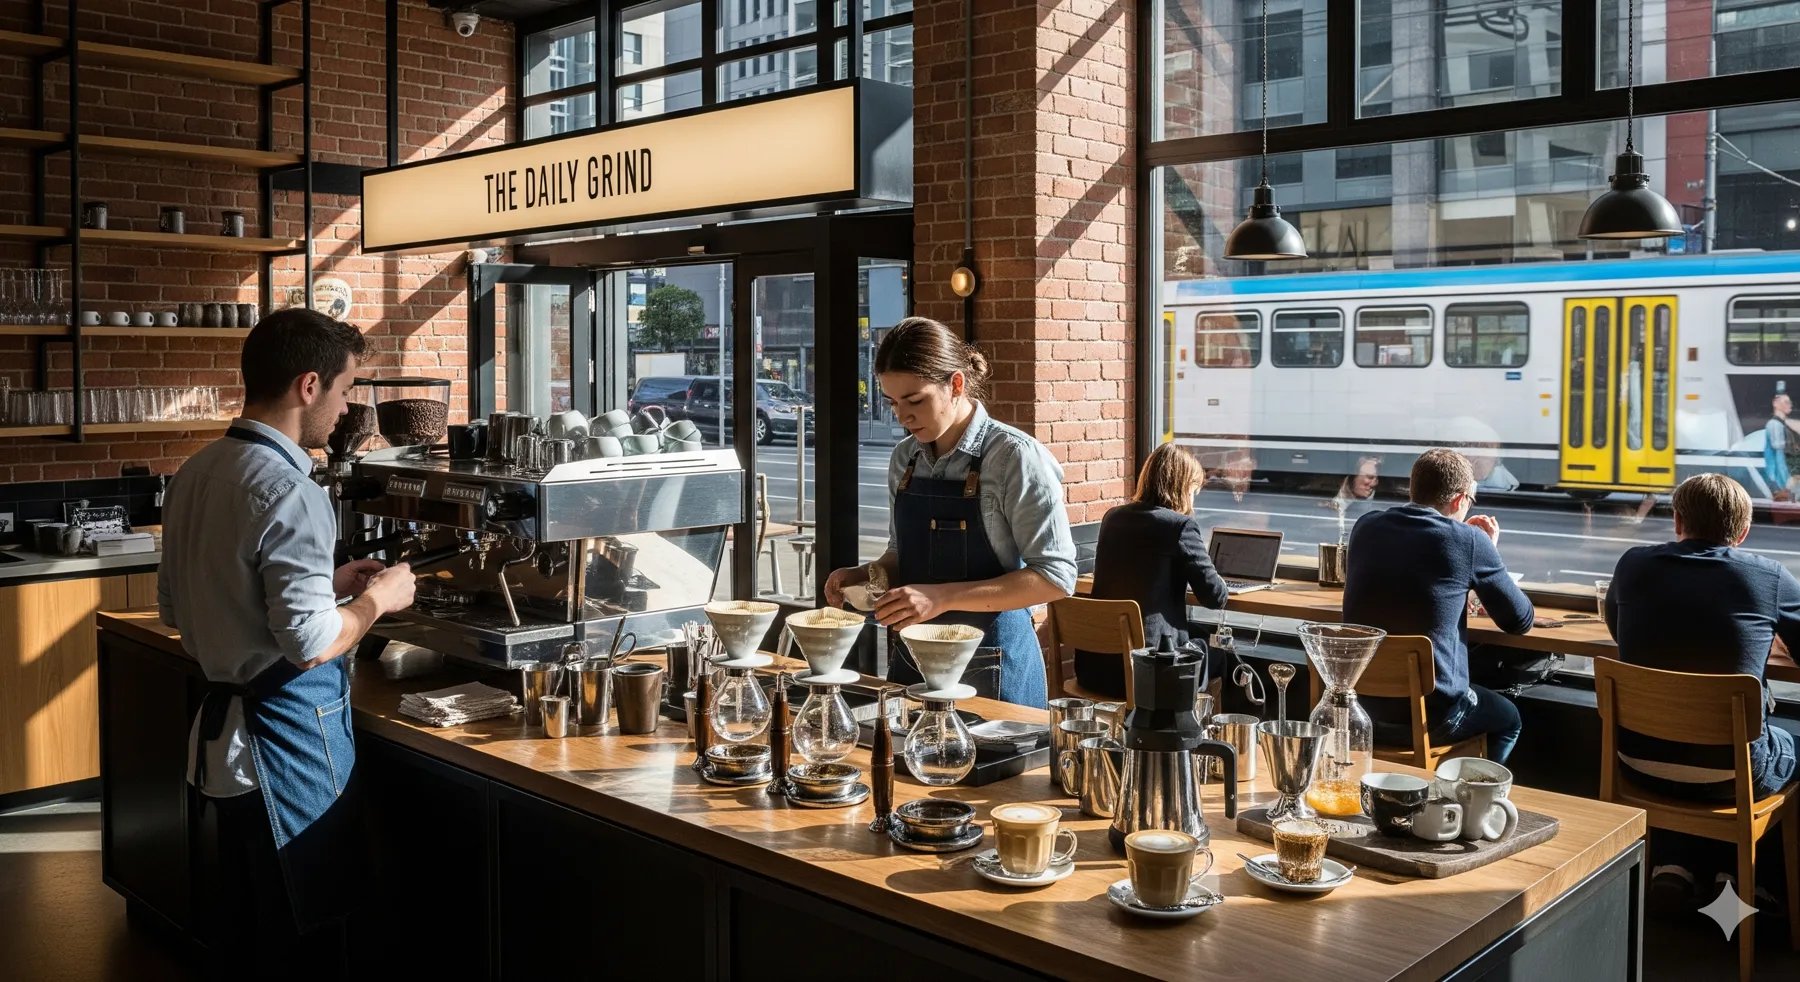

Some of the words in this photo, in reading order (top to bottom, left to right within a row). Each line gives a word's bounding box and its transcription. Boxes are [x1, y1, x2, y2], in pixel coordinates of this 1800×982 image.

[484, 170, 518, 214] THE
[525, 159, 579, 208] DAILY
[587, 148, 652, 200] GRIND
